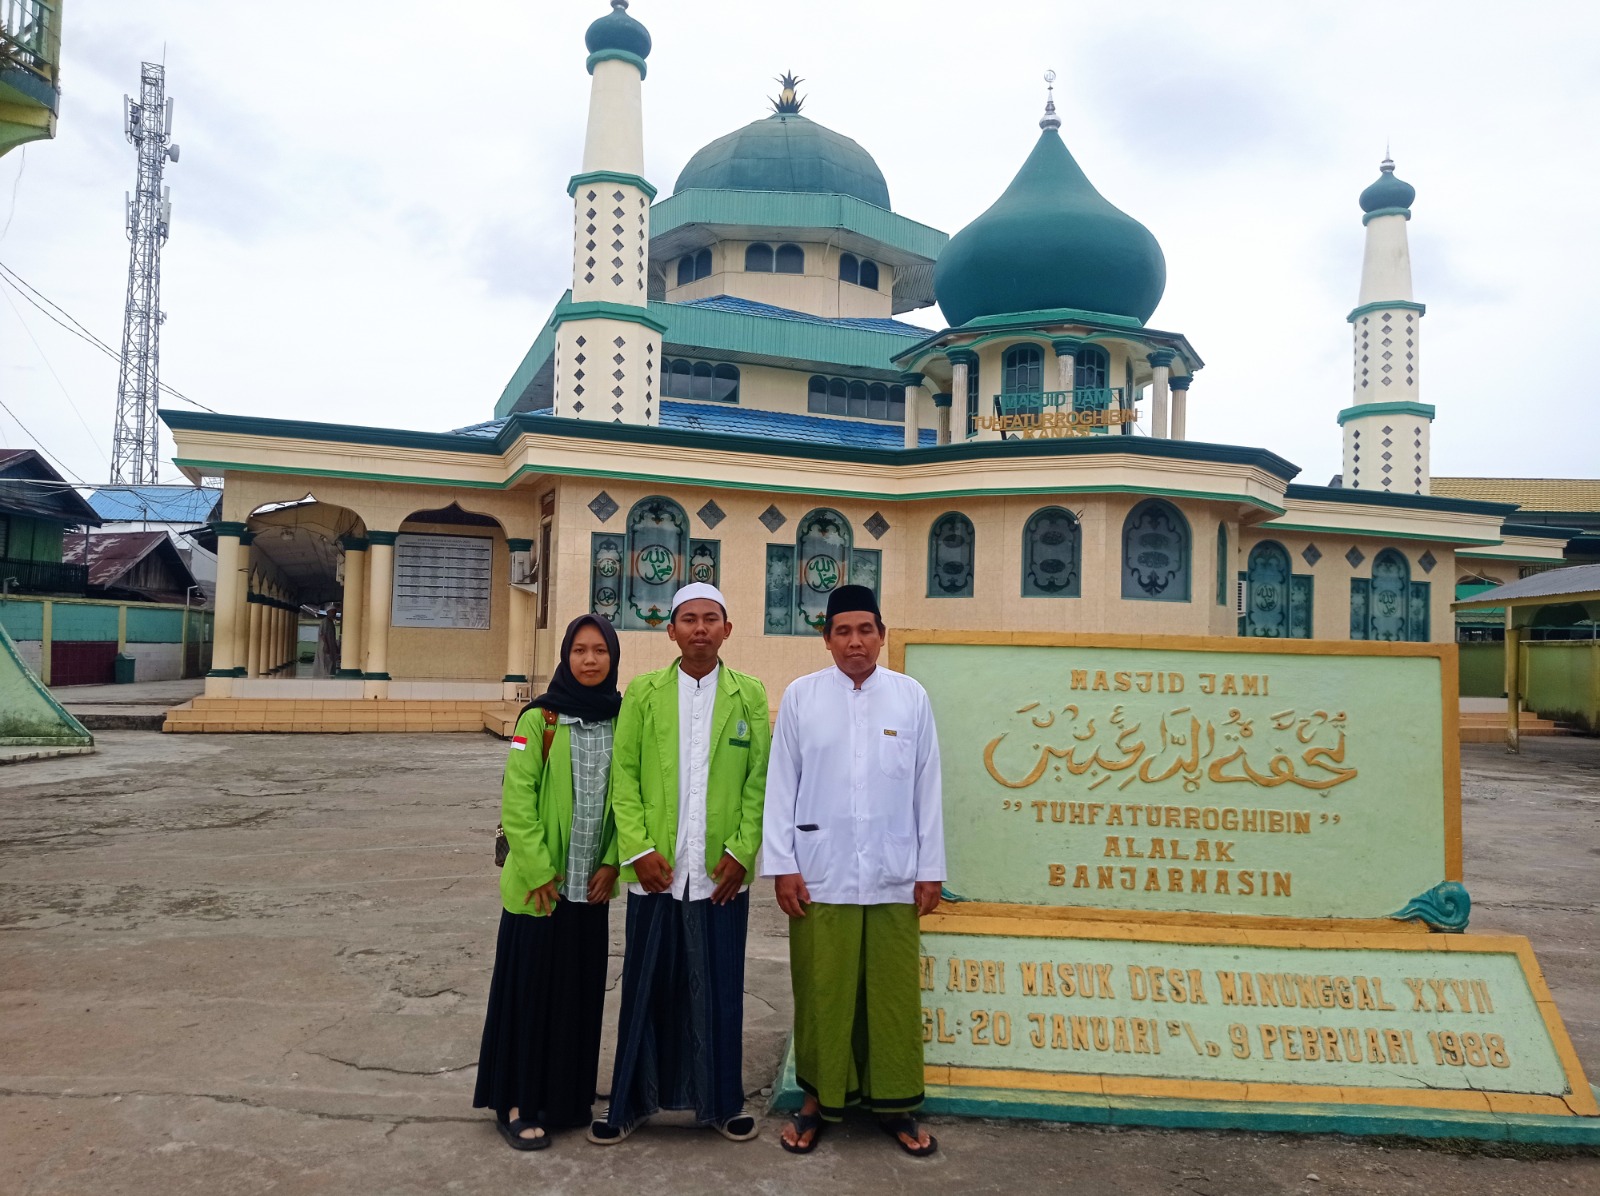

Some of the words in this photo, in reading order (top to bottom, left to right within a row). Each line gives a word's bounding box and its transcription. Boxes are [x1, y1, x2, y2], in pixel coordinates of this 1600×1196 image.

[1005, 392, 1066, 407] MASJID
[1074, 389, 1112, 405] JAMI
[972, 408, 1138, 430] TUHFATURROGHIBIN
[1070, 669, 1185, 693] MASJID
[1199, 673, 1269, 696] JAMI
[1104, 835, 1235, 862] ALALAK
[1048, 863, 1291, 897] BANJARMASIN
[948, 957, 1005, 993] ABRI
[1019, 960, 1115, 999] MASUK
[1128, 965, 1207, 1004] DESA
[1216, 970, 1396, 1011] MANUNGGAL
[1402, 977, 1494, 1014] XXVII
[1028, 1012, 1160, 1055] JANUARI
[1228, 1022, 1250, 1060] 9
[1259, 1024, 1418, 1065] PEBRUARI
[1427, 1030, 1510, 1068] 1988
